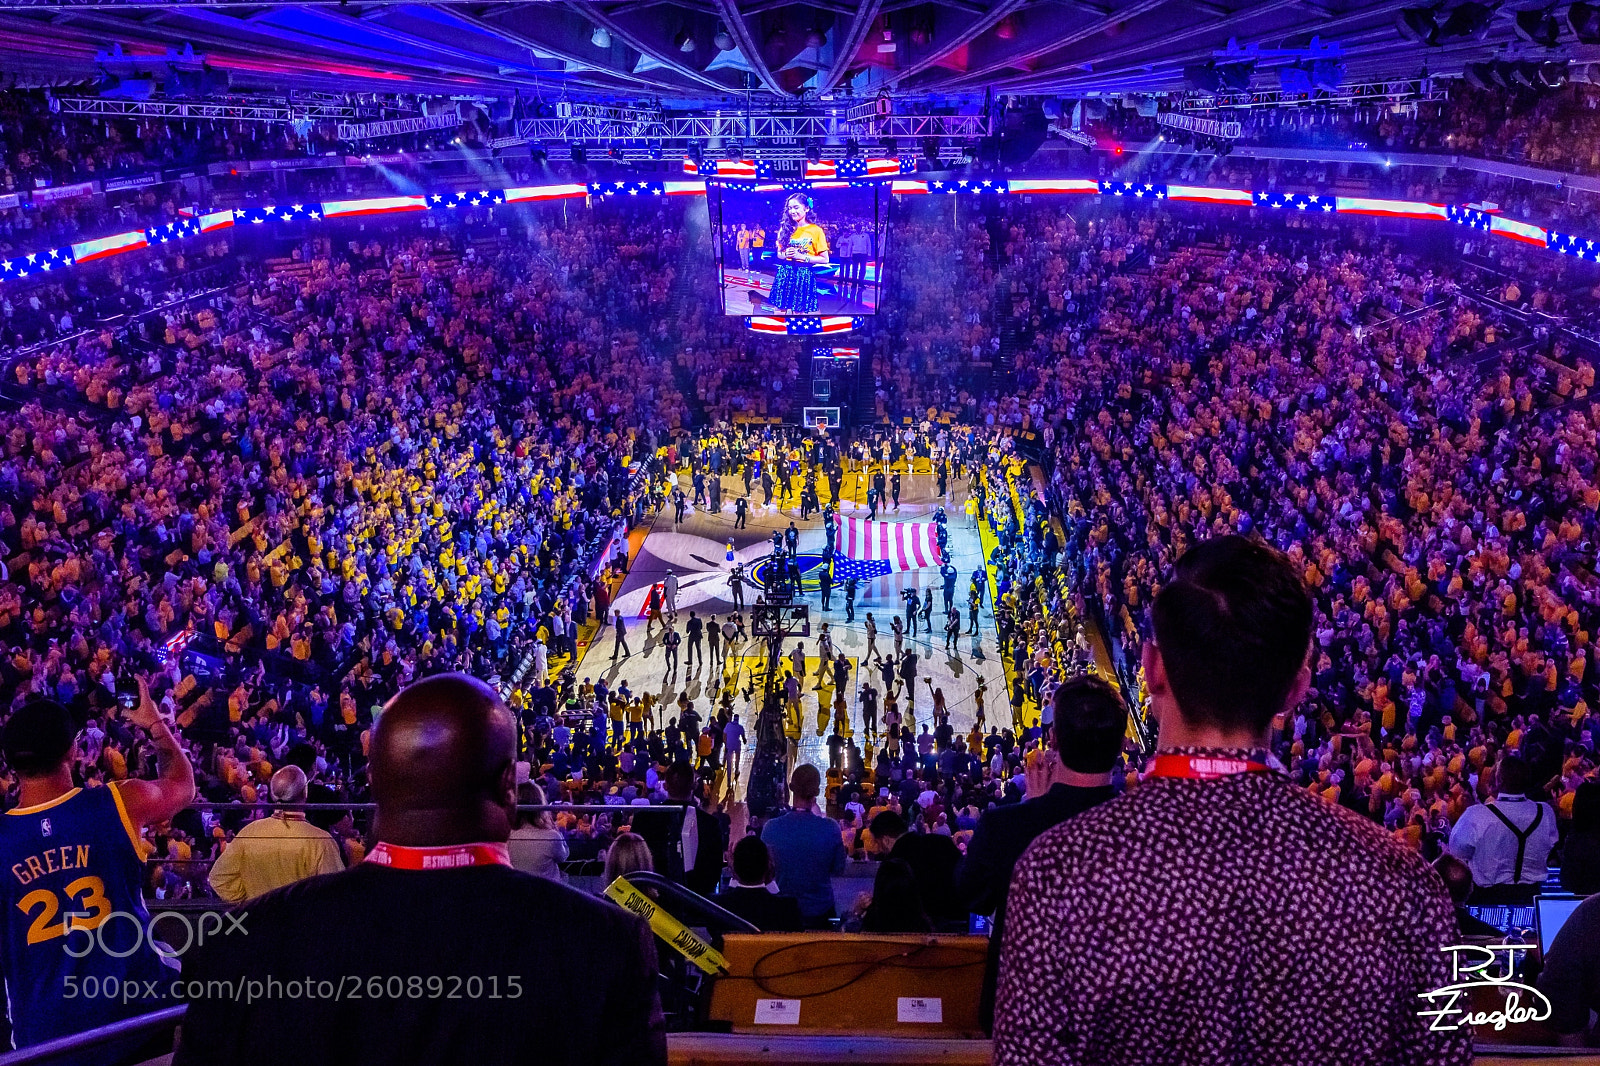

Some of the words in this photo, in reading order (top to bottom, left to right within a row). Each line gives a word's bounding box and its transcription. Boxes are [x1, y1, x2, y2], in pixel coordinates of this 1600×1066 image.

[773, 159, 799, 171] JBL
[12, 845, 90, 885] GREEN
[16, 876, 112, 946] 23
[625, 892, 656, 921] CUIDADO
[672, 930, 708, 959] CAUTION
